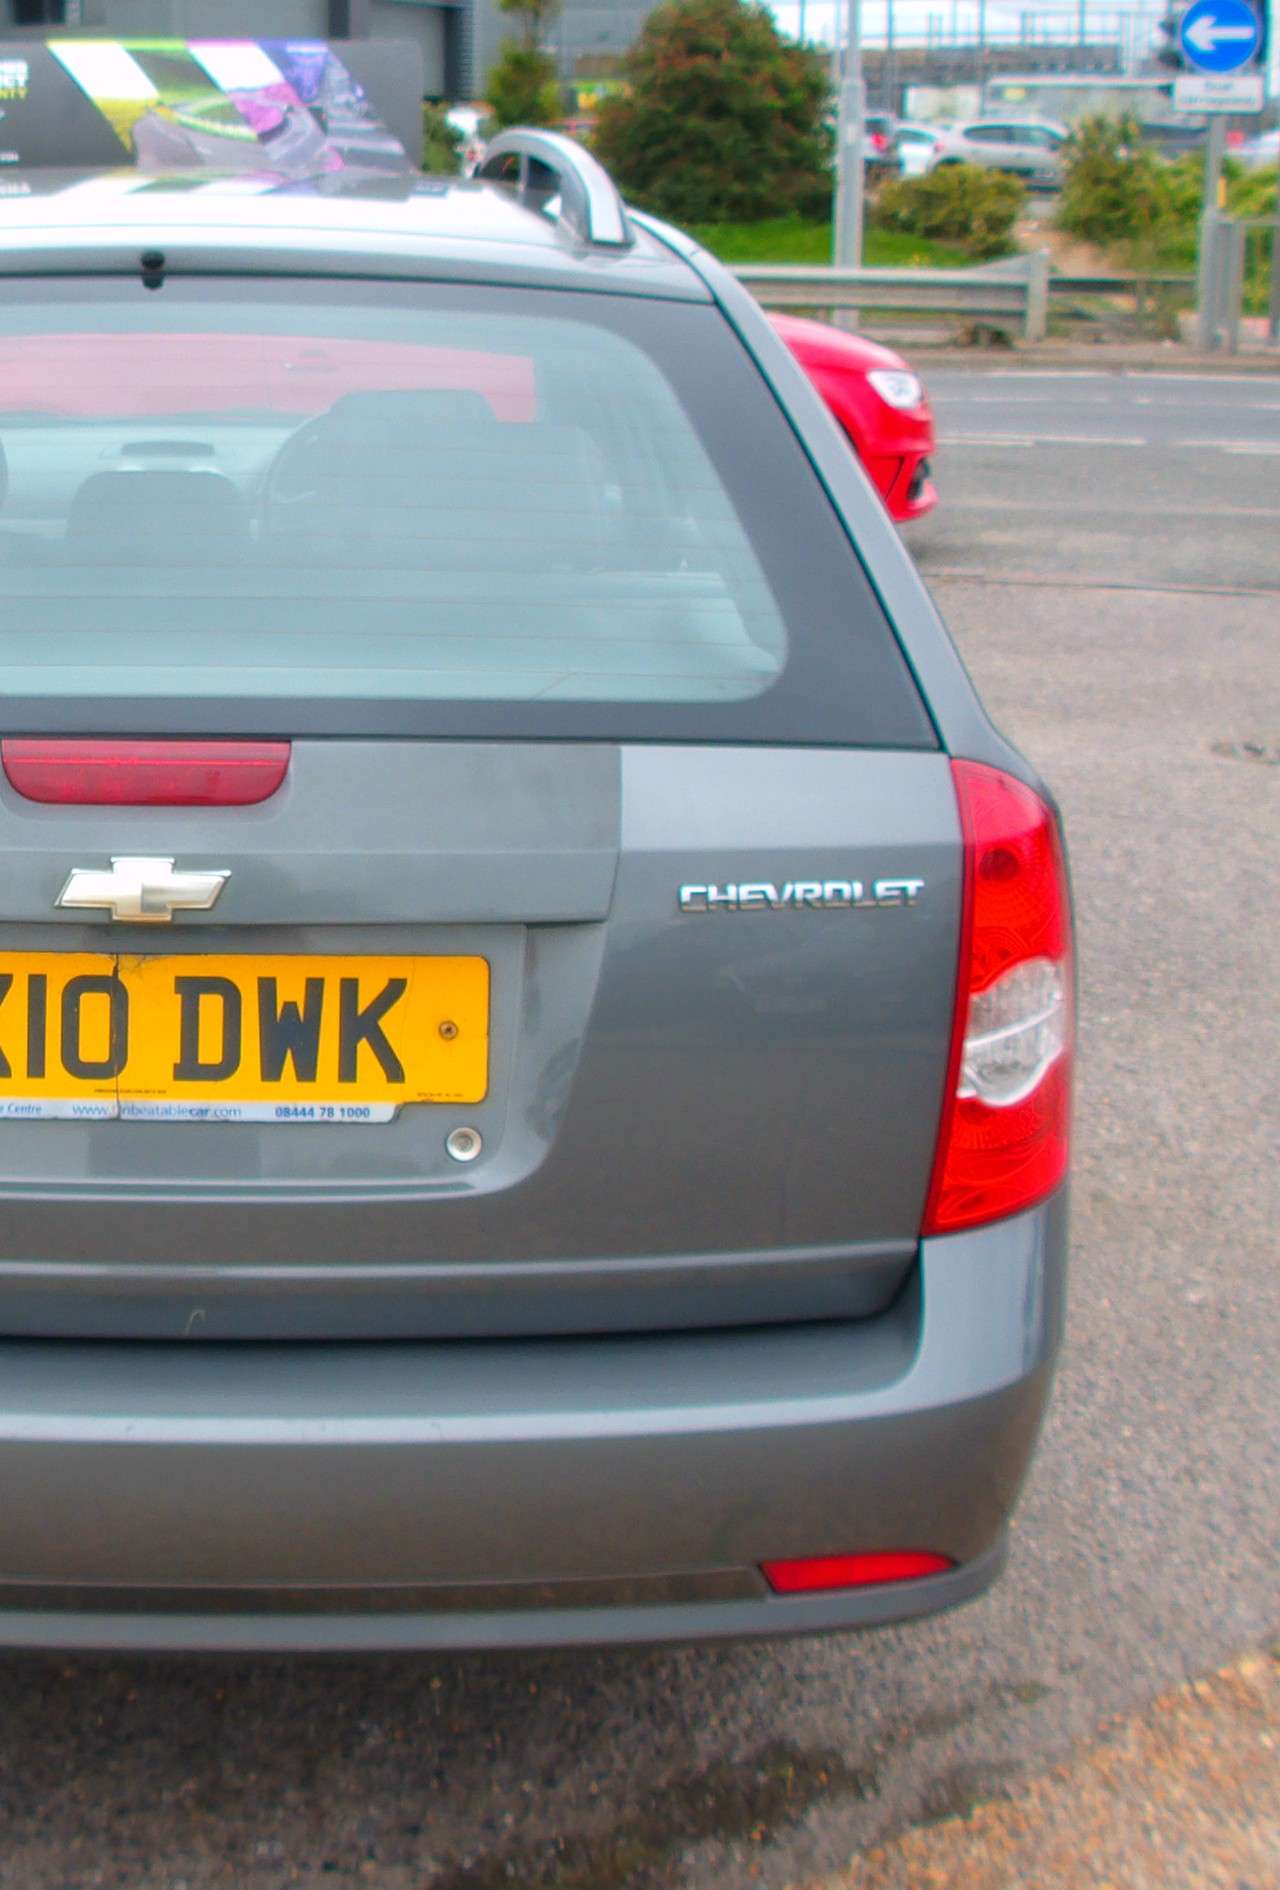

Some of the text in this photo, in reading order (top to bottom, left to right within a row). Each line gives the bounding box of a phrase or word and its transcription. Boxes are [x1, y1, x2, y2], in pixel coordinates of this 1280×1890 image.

[680, 878, 925, 912] CHEVROLET
[172, 975, 408, 1083] DWK
[7, 1102, 42, 1114] Centre
[275, 1106, 370, 1117] 08444 78 1000
